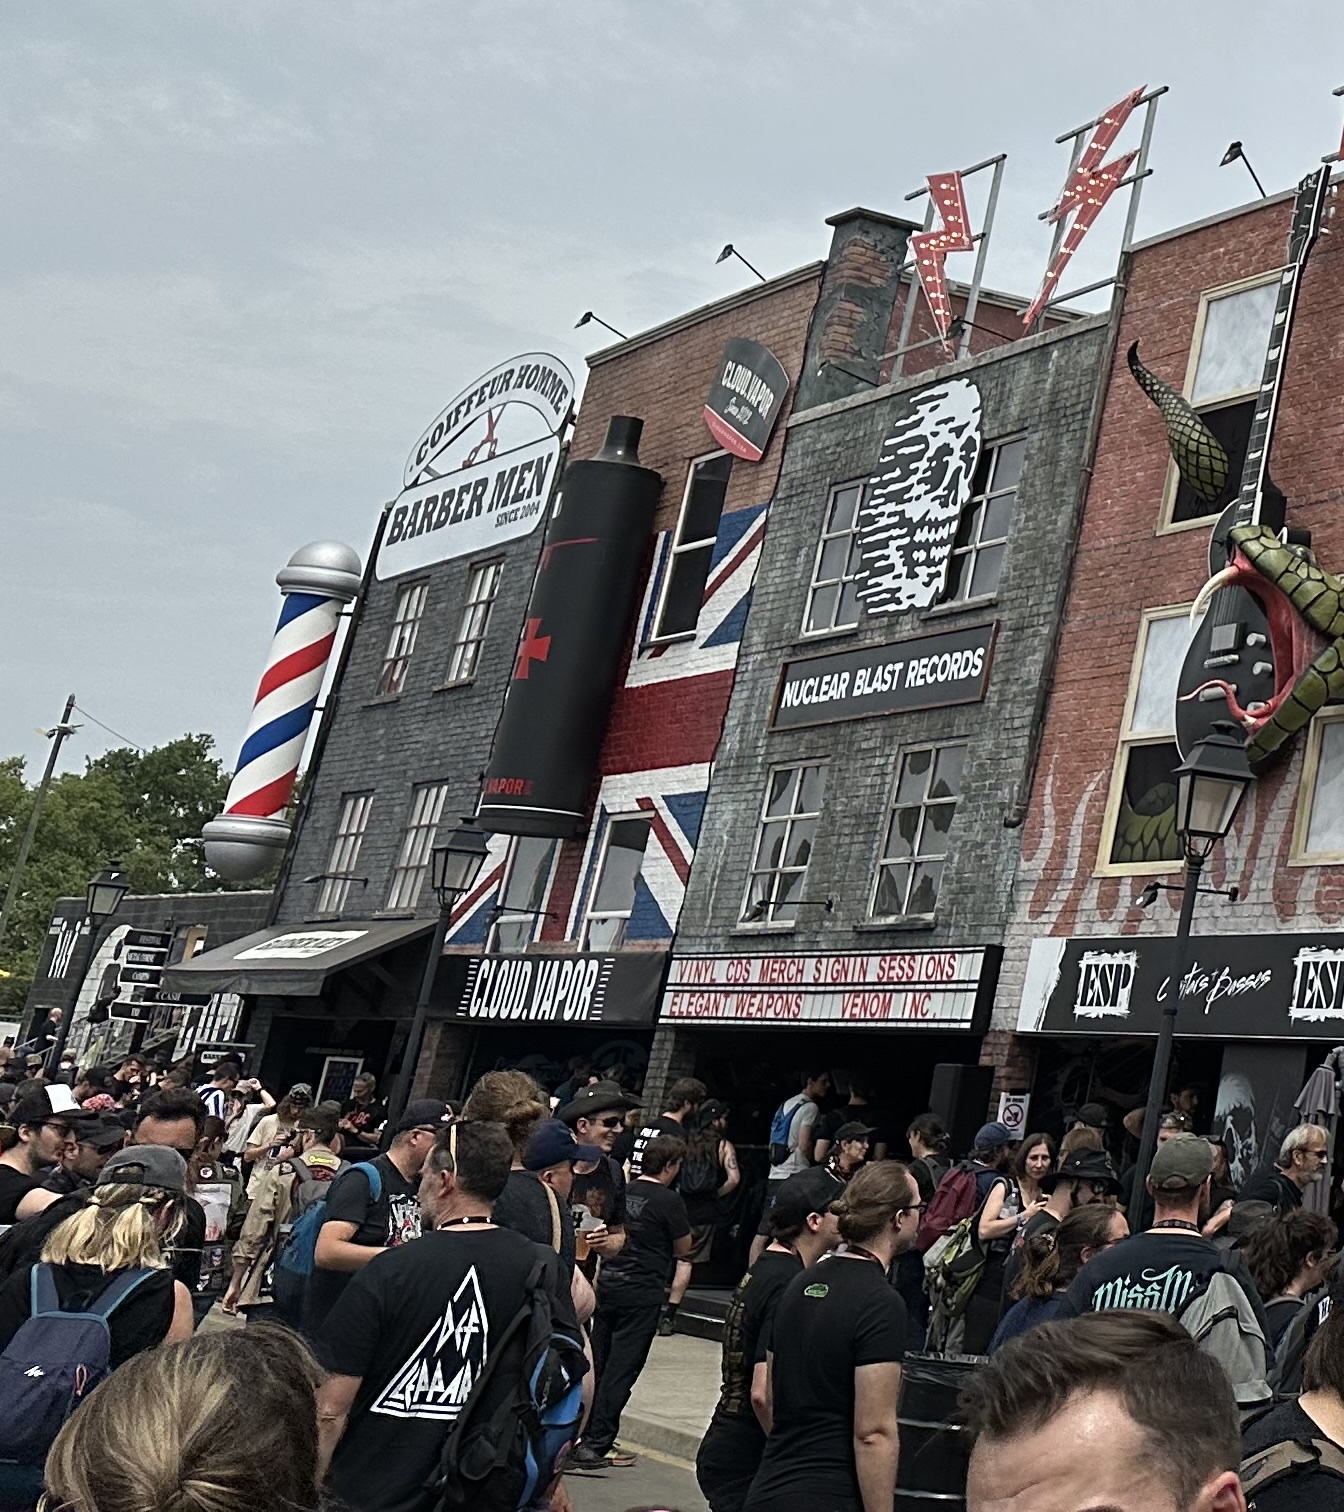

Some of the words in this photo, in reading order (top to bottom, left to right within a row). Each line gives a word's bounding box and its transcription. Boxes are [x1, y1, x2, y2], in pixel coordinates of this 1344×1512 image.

[415, 368, 515, 466] COIFFEUR
[513, 364, 569, 415] HOMME
[386, 477, 489, 546] BARBER
[487, 452, 553, 513] MEN
[495, 507, 518, 528] SINCE
[781, 672, 850, 708] NUCLEAR
[852, 662, 904, 697] BLAST
[905, 647, 985, 688] RECORDS
[469, 959, 600, 1021] CLOUD.VAPOR
[678, 959, 717, 983] VINYL
[726, 958, 751, 982] CDS
[759, 957, 805, 983] MERCH
[813, 956, 869, 982] SIGNIN
[877, 953, 956, 982] SESSIONS
[1079, 963, 1133, 1007] ESP
[1205, 966, 1272, 1015] Basses
[669, 992, 731, 1016] ELEGANT
[735, 993, 802, 1017] WEAPONS
[840, 992, 893, 1018] VENOM
[901, 994, 937, 1018] INC.
[433, 1300, 480, 1359] DEF
[389, 1358, 481, 1411] LEPPAR
